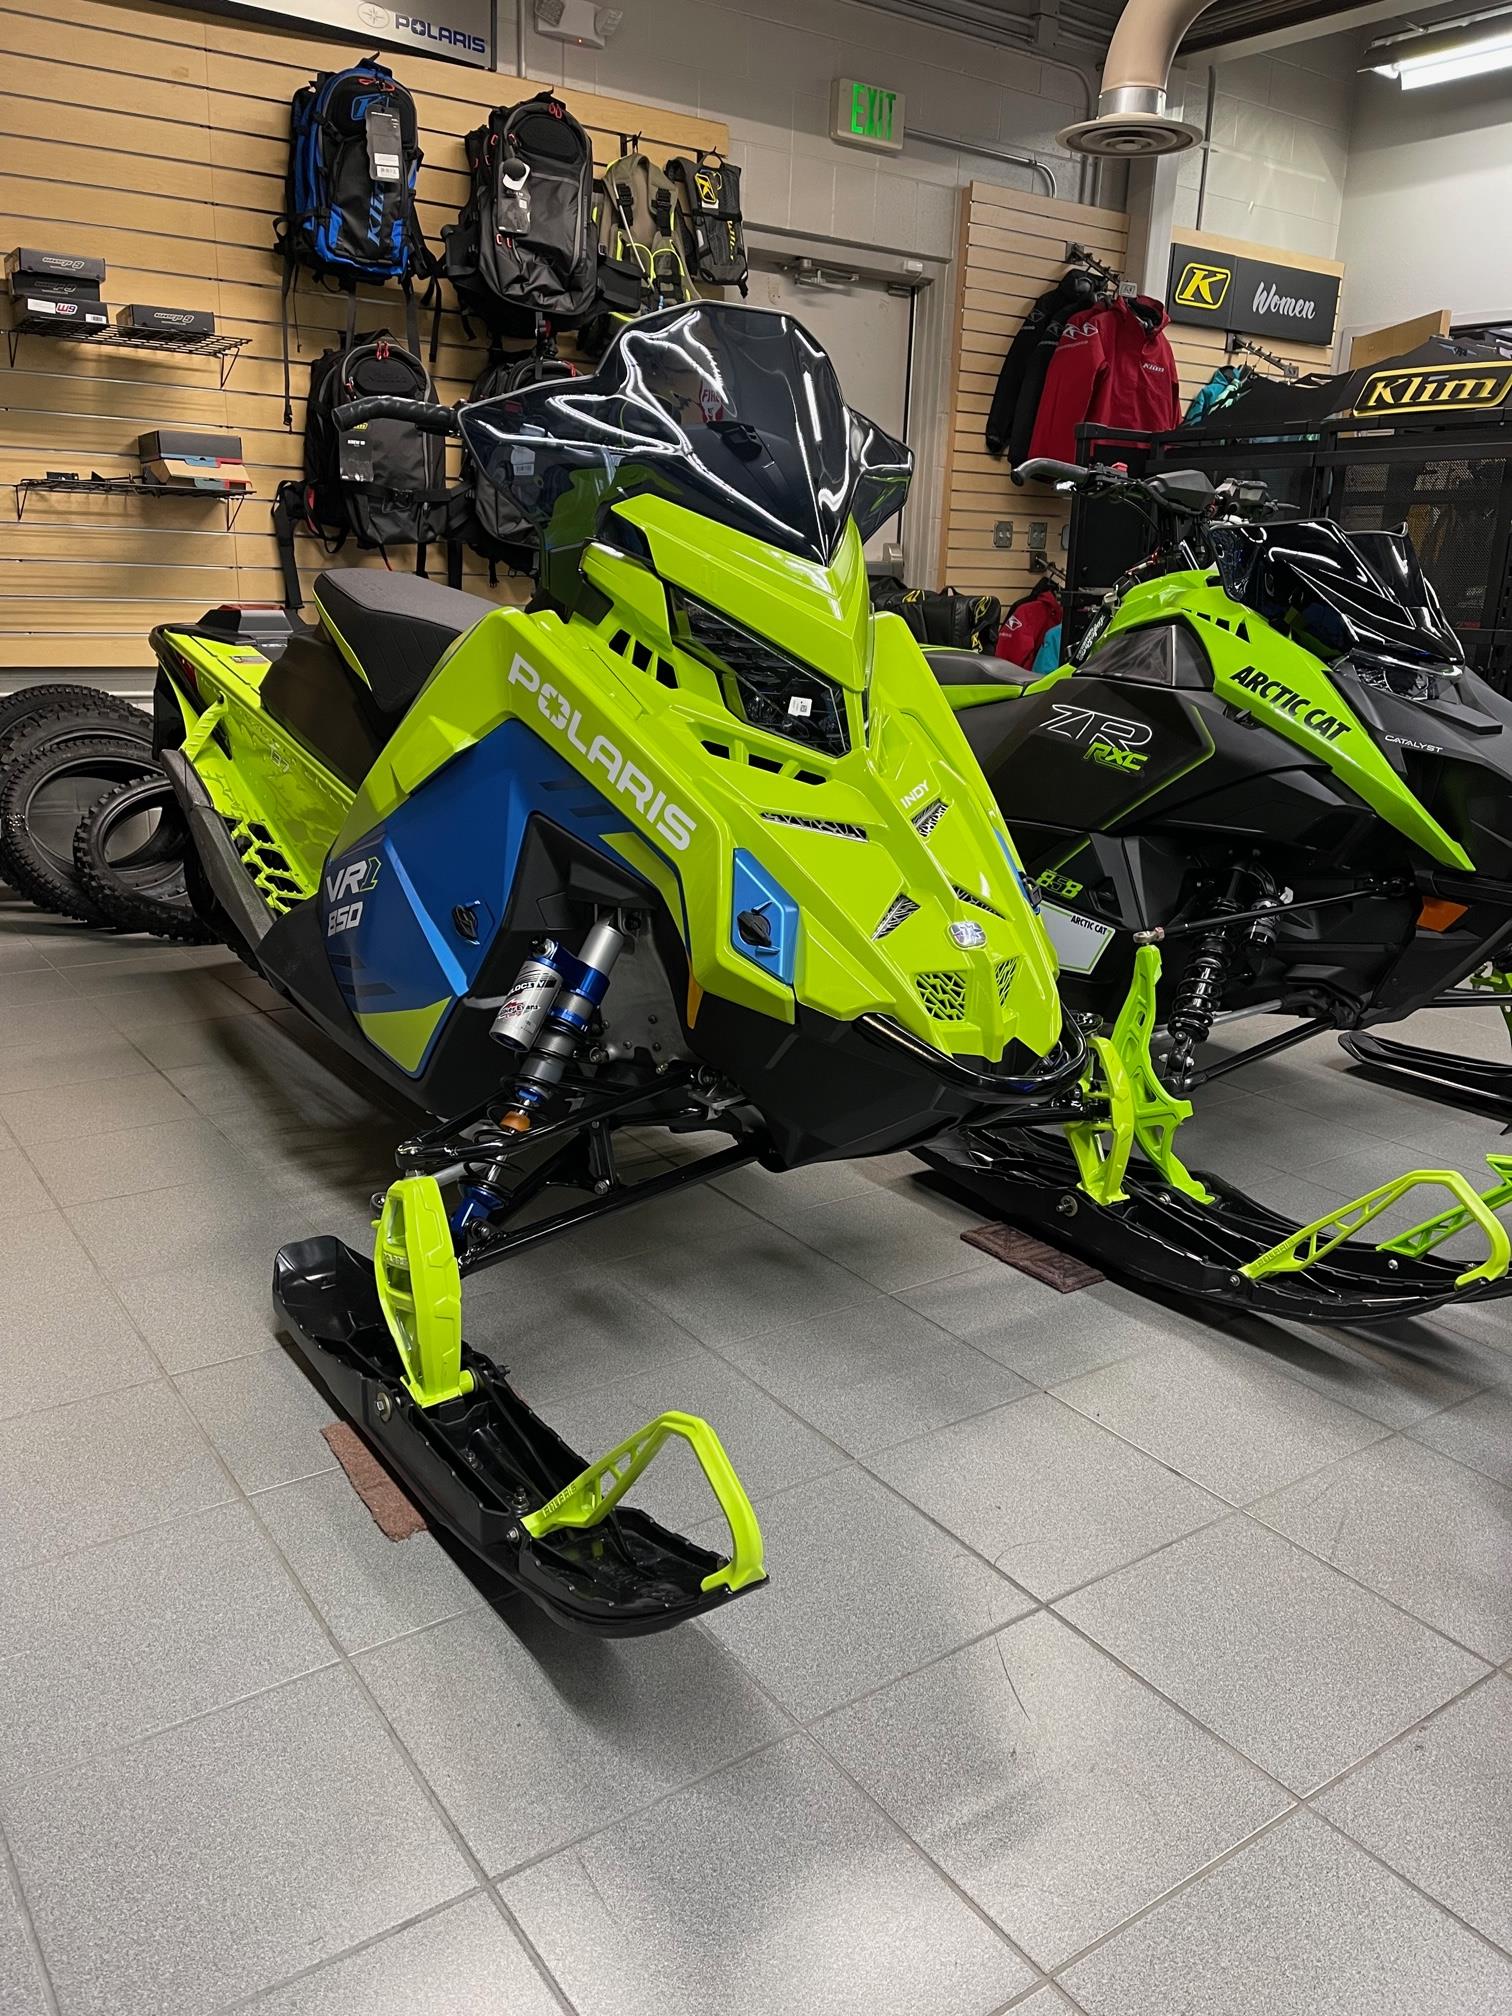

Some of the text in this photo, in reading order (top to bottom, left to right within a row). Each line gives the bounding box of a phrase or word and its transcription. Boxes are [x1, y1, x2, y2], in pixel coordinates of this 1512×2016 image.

[395, 13, 486, 54] POLARIS
[851, 82, 897, 142] EXIT
[1252, 281, 1316, 320] Women
[1367, 375, 1498, 407] Klim
[1229, 665, 1353, 742] ARCTIC CAT
[1039, 703, 1153, 753] ZR
[1384, 734, 1444, 753] CATALYST
[508, 652, 697, 851] POLARIS
[1083, 742, 1149, 771] RXC
[900, 779, 930, 809] INDY
[327, 901, 364, 937] 850
[1070, 915, 1108, 935] ARCTIC CAT
